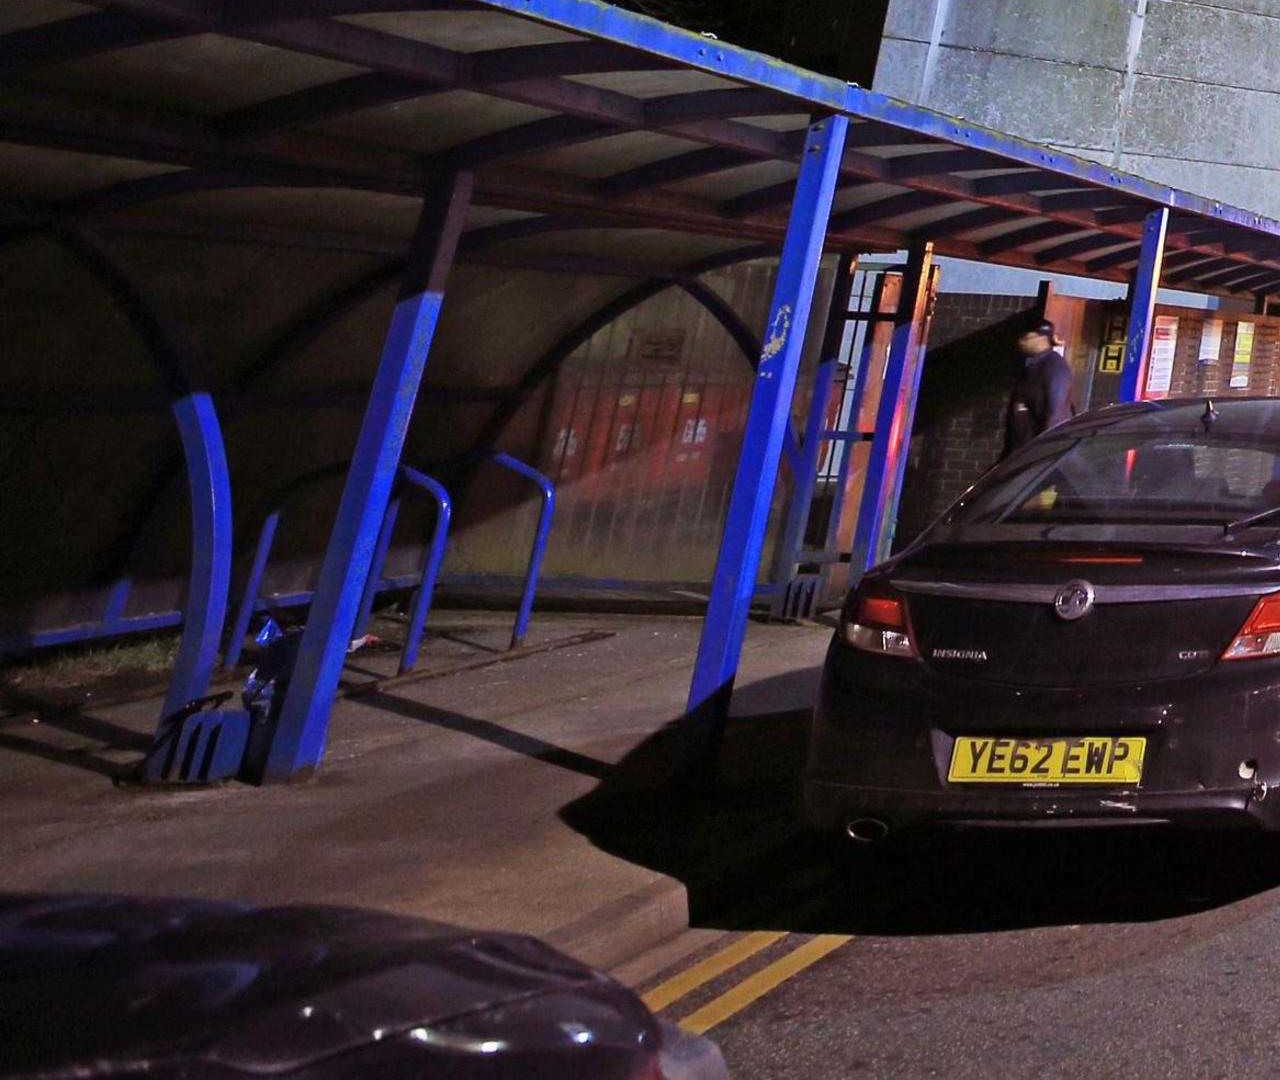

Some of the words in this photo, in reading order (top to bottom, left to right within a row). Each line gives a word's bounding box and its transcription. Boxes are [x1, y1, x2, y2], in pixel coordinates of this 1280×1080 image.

[1102, 346, 1123, 370] H
[969, 740, 1053, 774] YE62
[1060, 741, 1130, 775] EWP
